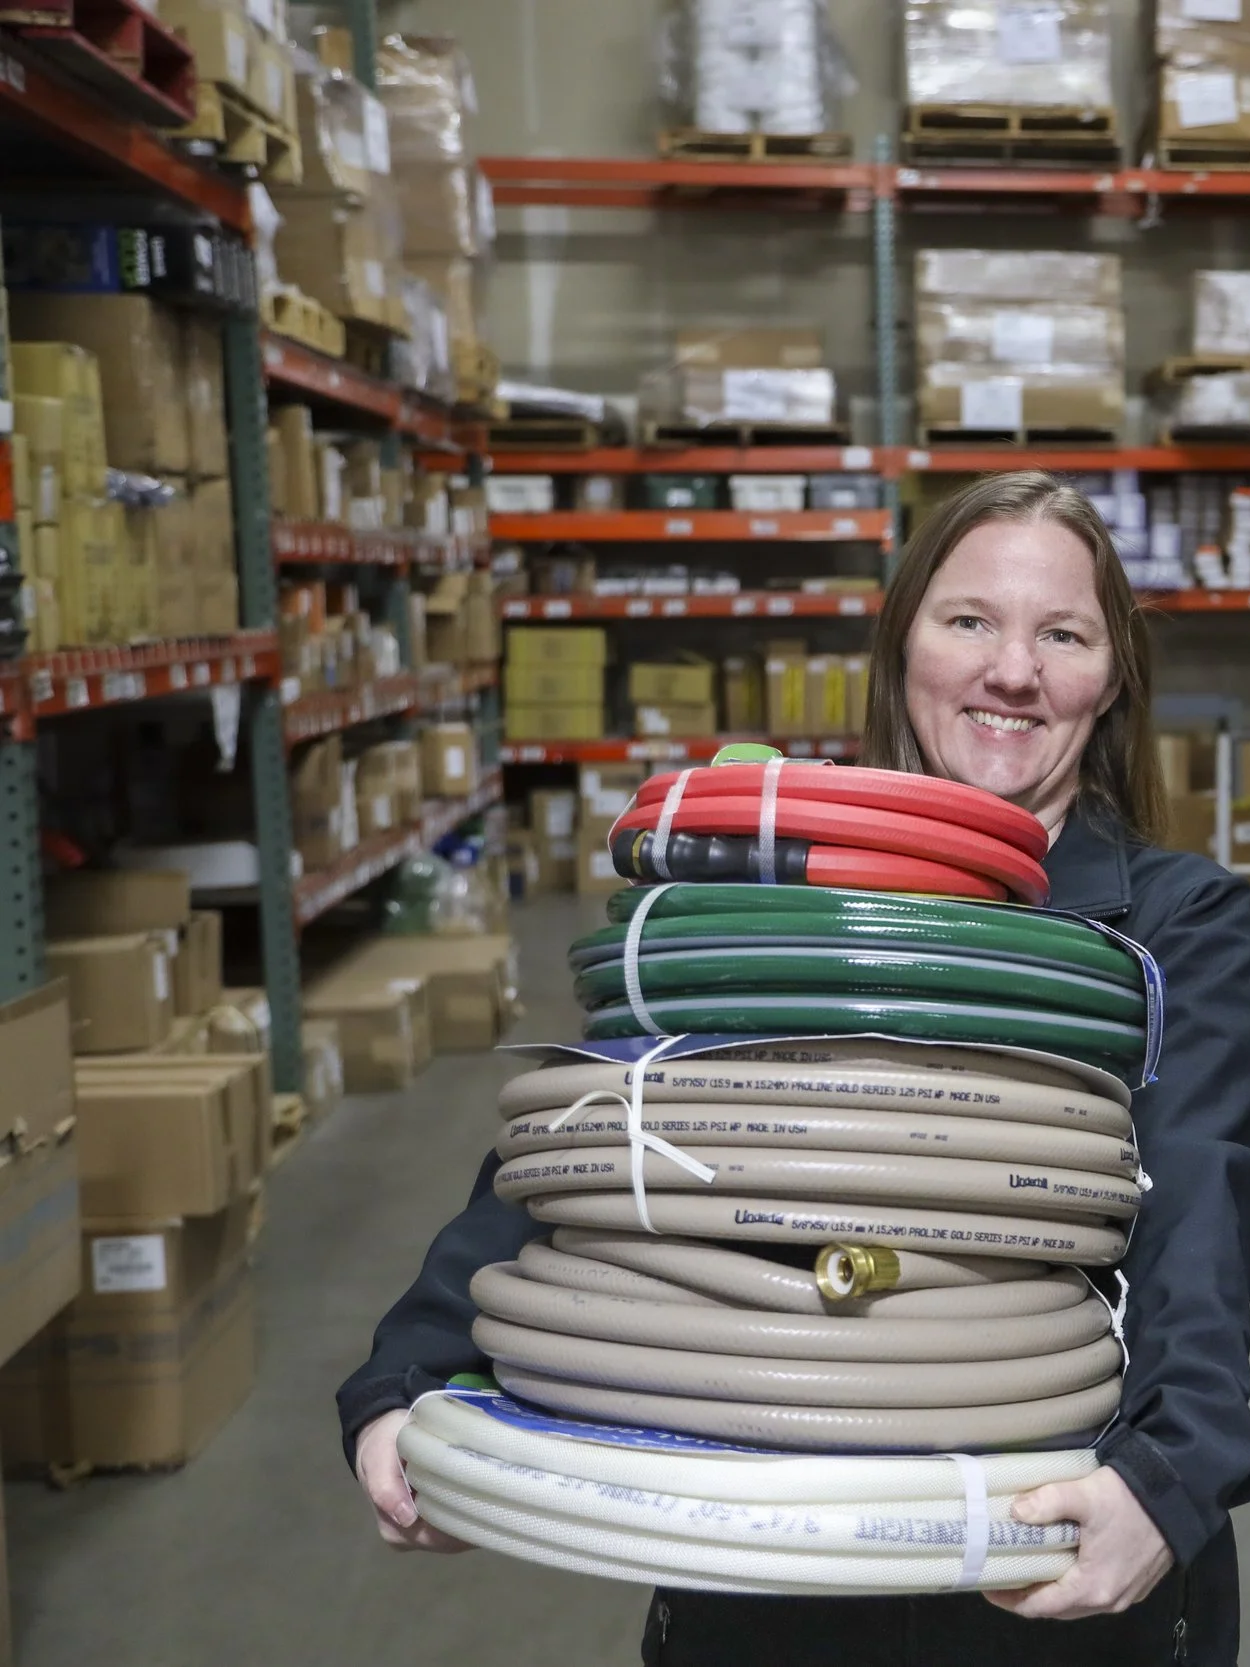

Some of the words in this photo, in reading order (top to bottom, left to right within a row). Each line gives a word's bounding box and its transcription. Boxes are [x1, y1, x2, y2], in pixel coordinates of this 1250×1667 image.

[746, 1080, 752, 1089] X
[791, 1082, 833, 1093] PROLINE
[836, 1083, 859, 1094] GOLD
[863, 1085, 896, 1097] SERIES
[899, 1086, 916, 1098] 125
[918, 1087, 932, 1099] PSI
[935, 1089, 944, 1100] WP
[950, 1091, 971, 1102] MADE
[973, 1093, 983, 1103] IN
[985, 1095, 1000, 1105] USA
[607, 1120, 628, 1132] PROLI
[641, 1120, 659, 1132] GOLD
[662, 1120, 690, 1132] SERIES
[692, 1120, 708, 1132] 125
[711, 1121, 728, 1132] PSI
[730, 1121, 742, 1132] WP
[747, 1121, 769, 1133] MADE
[774, 1123, 786, 1134] IN
[788, 1124, 808, 1134] USA
[552, 1165, 562, 1175] PSI
[573, 1163, 588, 1174] MADE
[590, 1162, 599, 1173] IN
[601, 1162, 615, 1173] USA
[1009, 1173, 1048, 1190] Underhill
[868, 1224, 874, 1233] X
[909, 1226, 947, 1239] PROLINE
[951, 1229, 972, 1241] GOLD
[974, 1231, 1002, 1244] SERIES
[1004, 1234, 1017, 1245] 125
[1019, 1235, 1031, 1246] PSI
[1031, 1237, 1041, 1248] WP
[1043, 1238, 1057, 1248] MADE
[1058, 1238, 1066, 1249] IN
[1066, 1239, 1075, 1249] USA
